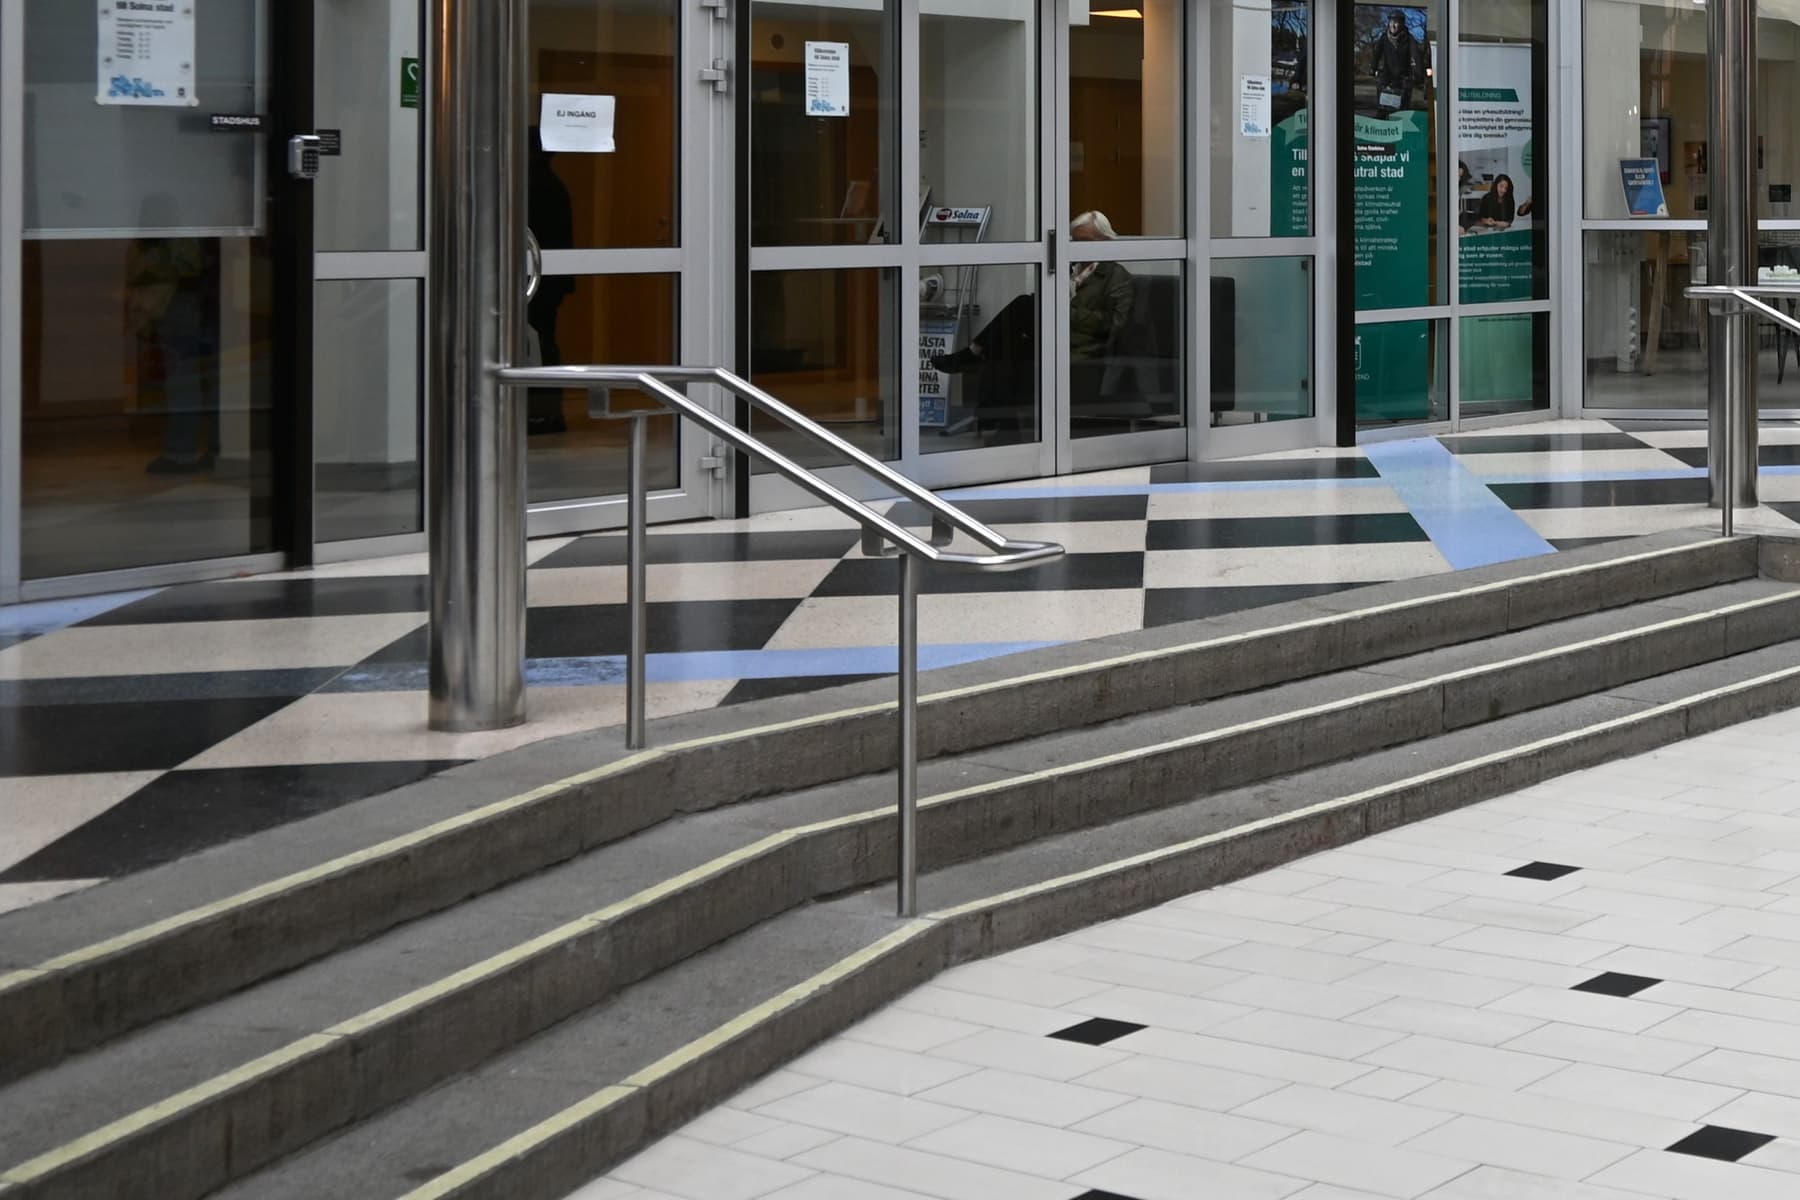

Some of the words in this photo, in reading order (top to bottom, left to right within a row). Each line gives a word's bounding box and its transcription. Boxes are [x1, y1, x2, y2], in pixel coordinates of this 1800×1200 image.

[212, 116, 260, 126] STADSHUS
[1364, 125, 1399, 136] klimatet
[1400, 150, 1410, 162] vi
[1291, 167, 1305, 176] en
[1354, 166, 1377, 178] utral
[1380, 166, 1404, 178] stad
[952, 210, 979, 219] Solna
[919, 336, 946, 348] ÄSTA
